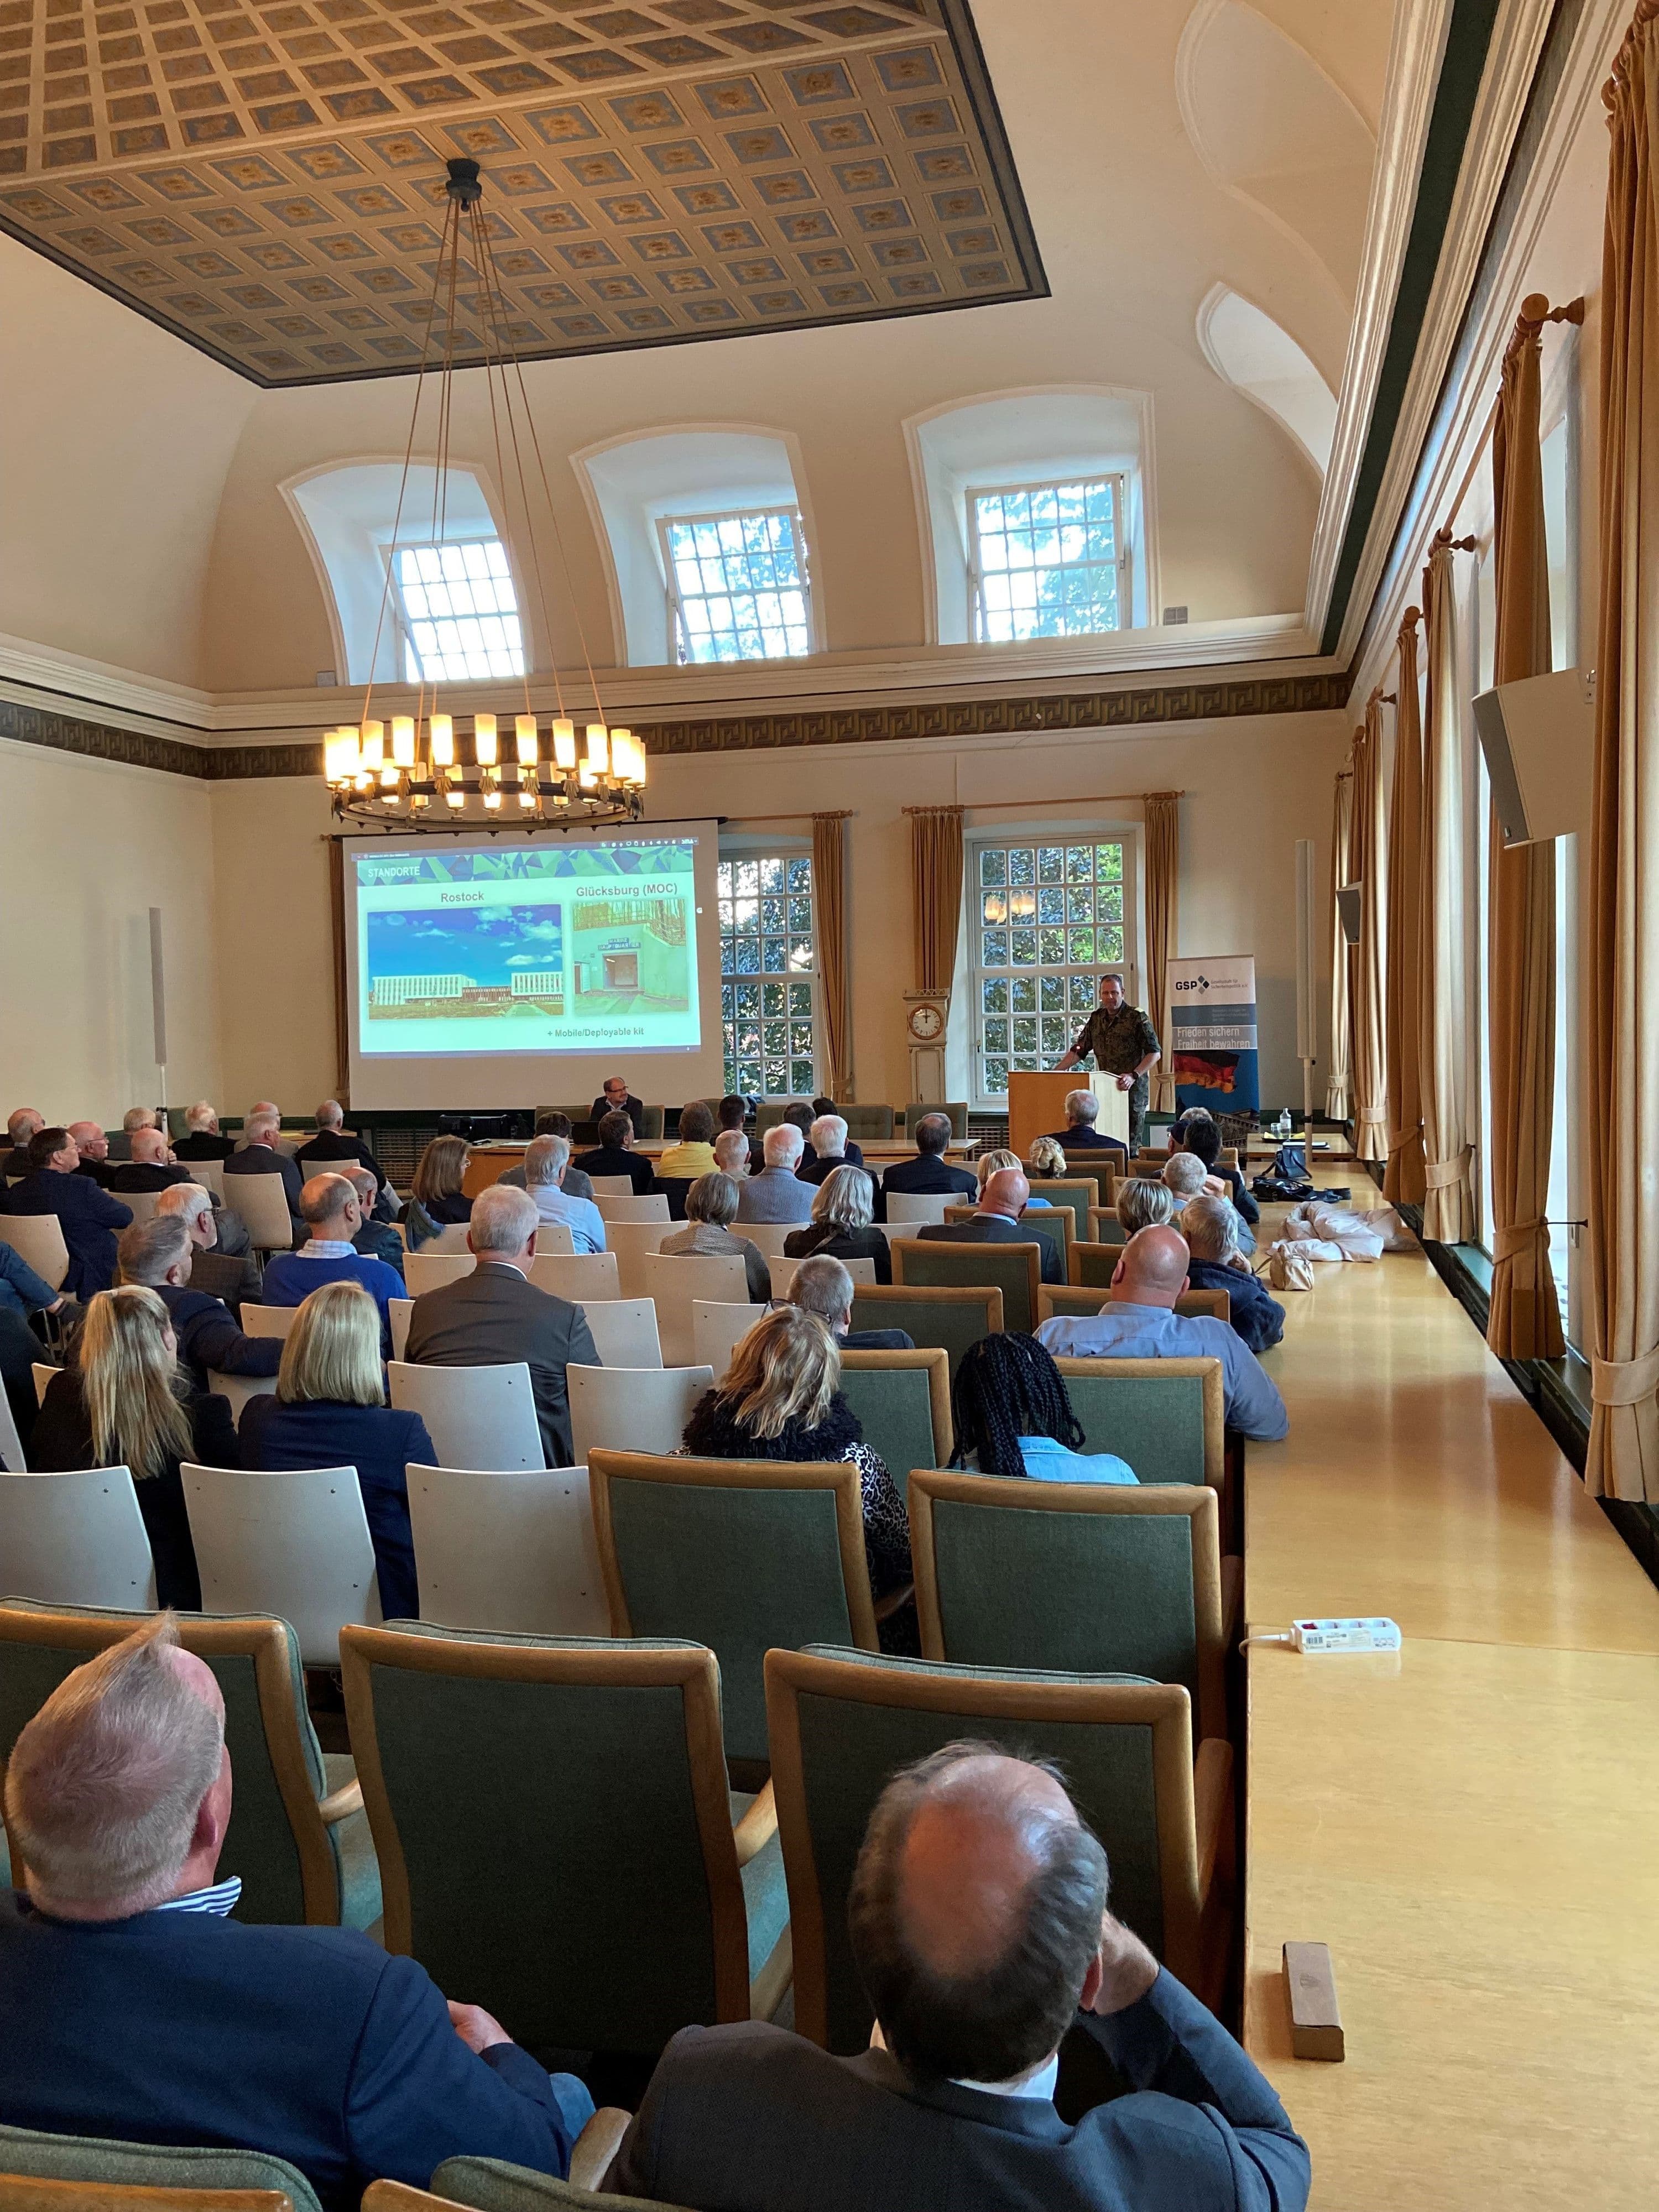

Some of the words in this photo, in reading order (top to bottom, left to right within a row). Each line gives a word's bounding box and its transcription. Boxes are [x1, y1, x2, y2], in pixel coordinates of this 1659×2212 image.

[368, 866, 420, 877] STANDORTE
[576, 886, 639, 897] Glücksburg
[643, 883, 677, 896] (MOC)
[441, 890, 484, 902] Rostock
[1176, 981, 1197, 990] GSP
[555, 1028, 631, 1037] Mobile/Deployable
[1177, 1027, 1207, 1037] Frieden
[1209, 1027, 1239, 1036] sichern
[1178, 1040, 1207, 1049] Freiheit
[1209, 1039, 1250, 1049] bewahren
